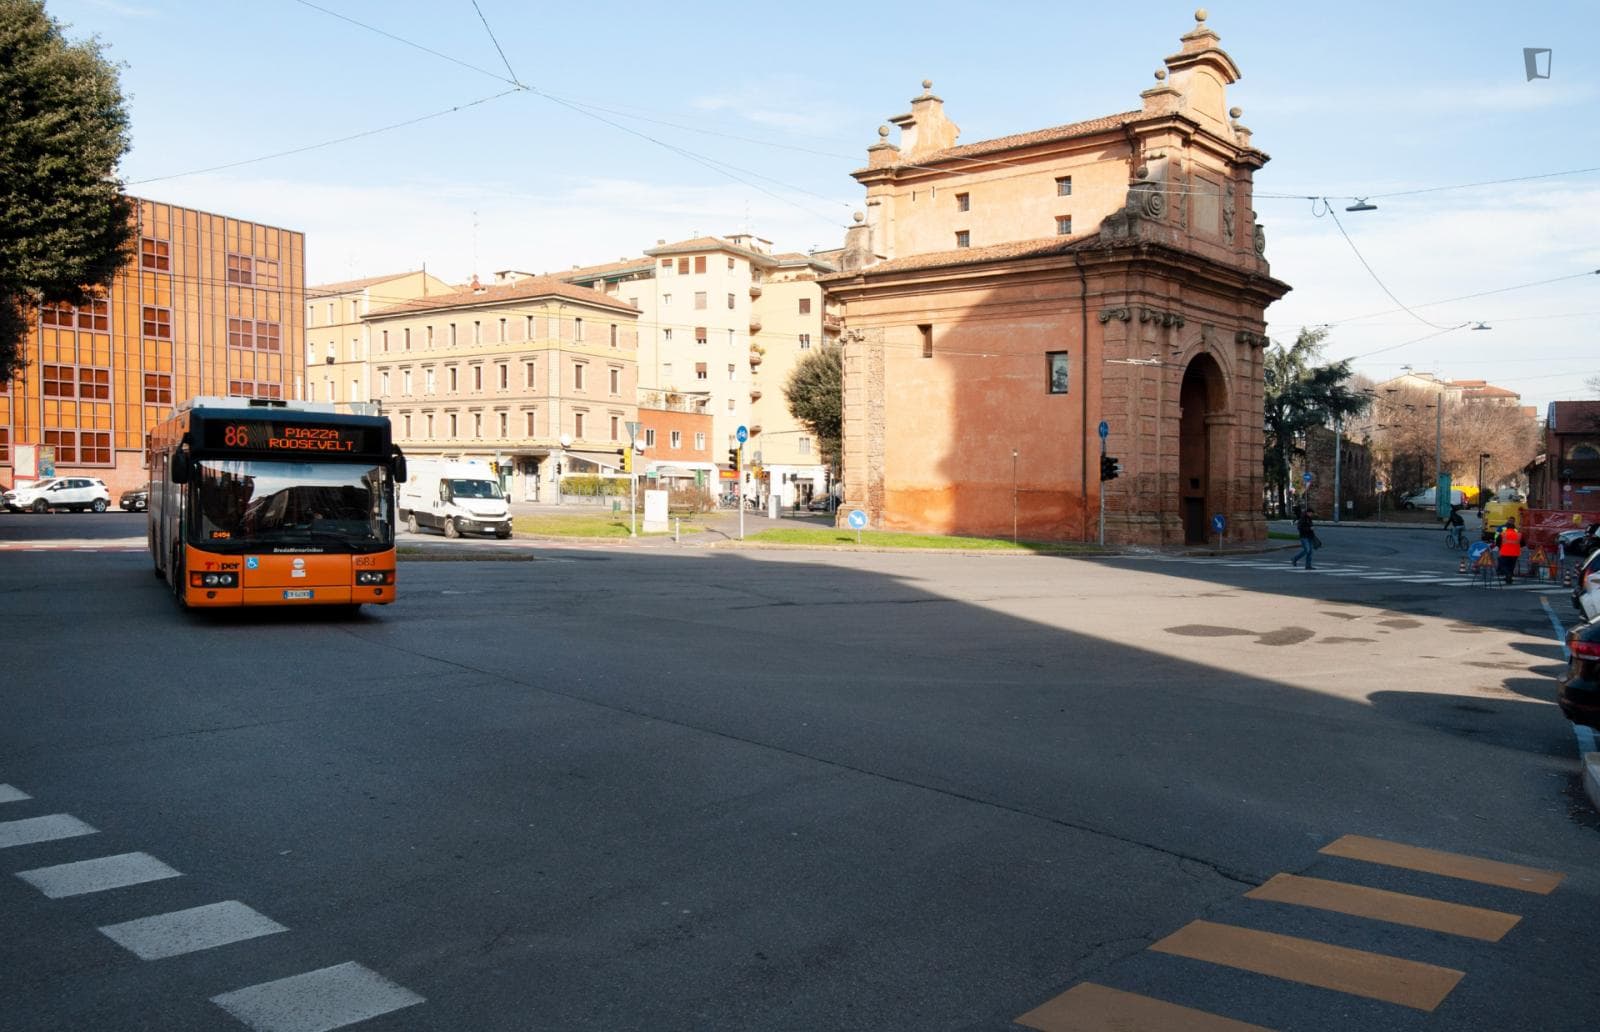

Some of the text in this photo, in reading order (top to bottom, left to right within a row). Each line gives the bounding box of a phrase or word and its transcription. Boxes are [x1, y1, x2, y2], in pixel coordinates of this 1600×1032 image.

[224, 425, 248, 446] 86
[285, 428, 339, 439] PIAZZA
[269, 438, 354, 451] ROOSEVELT
